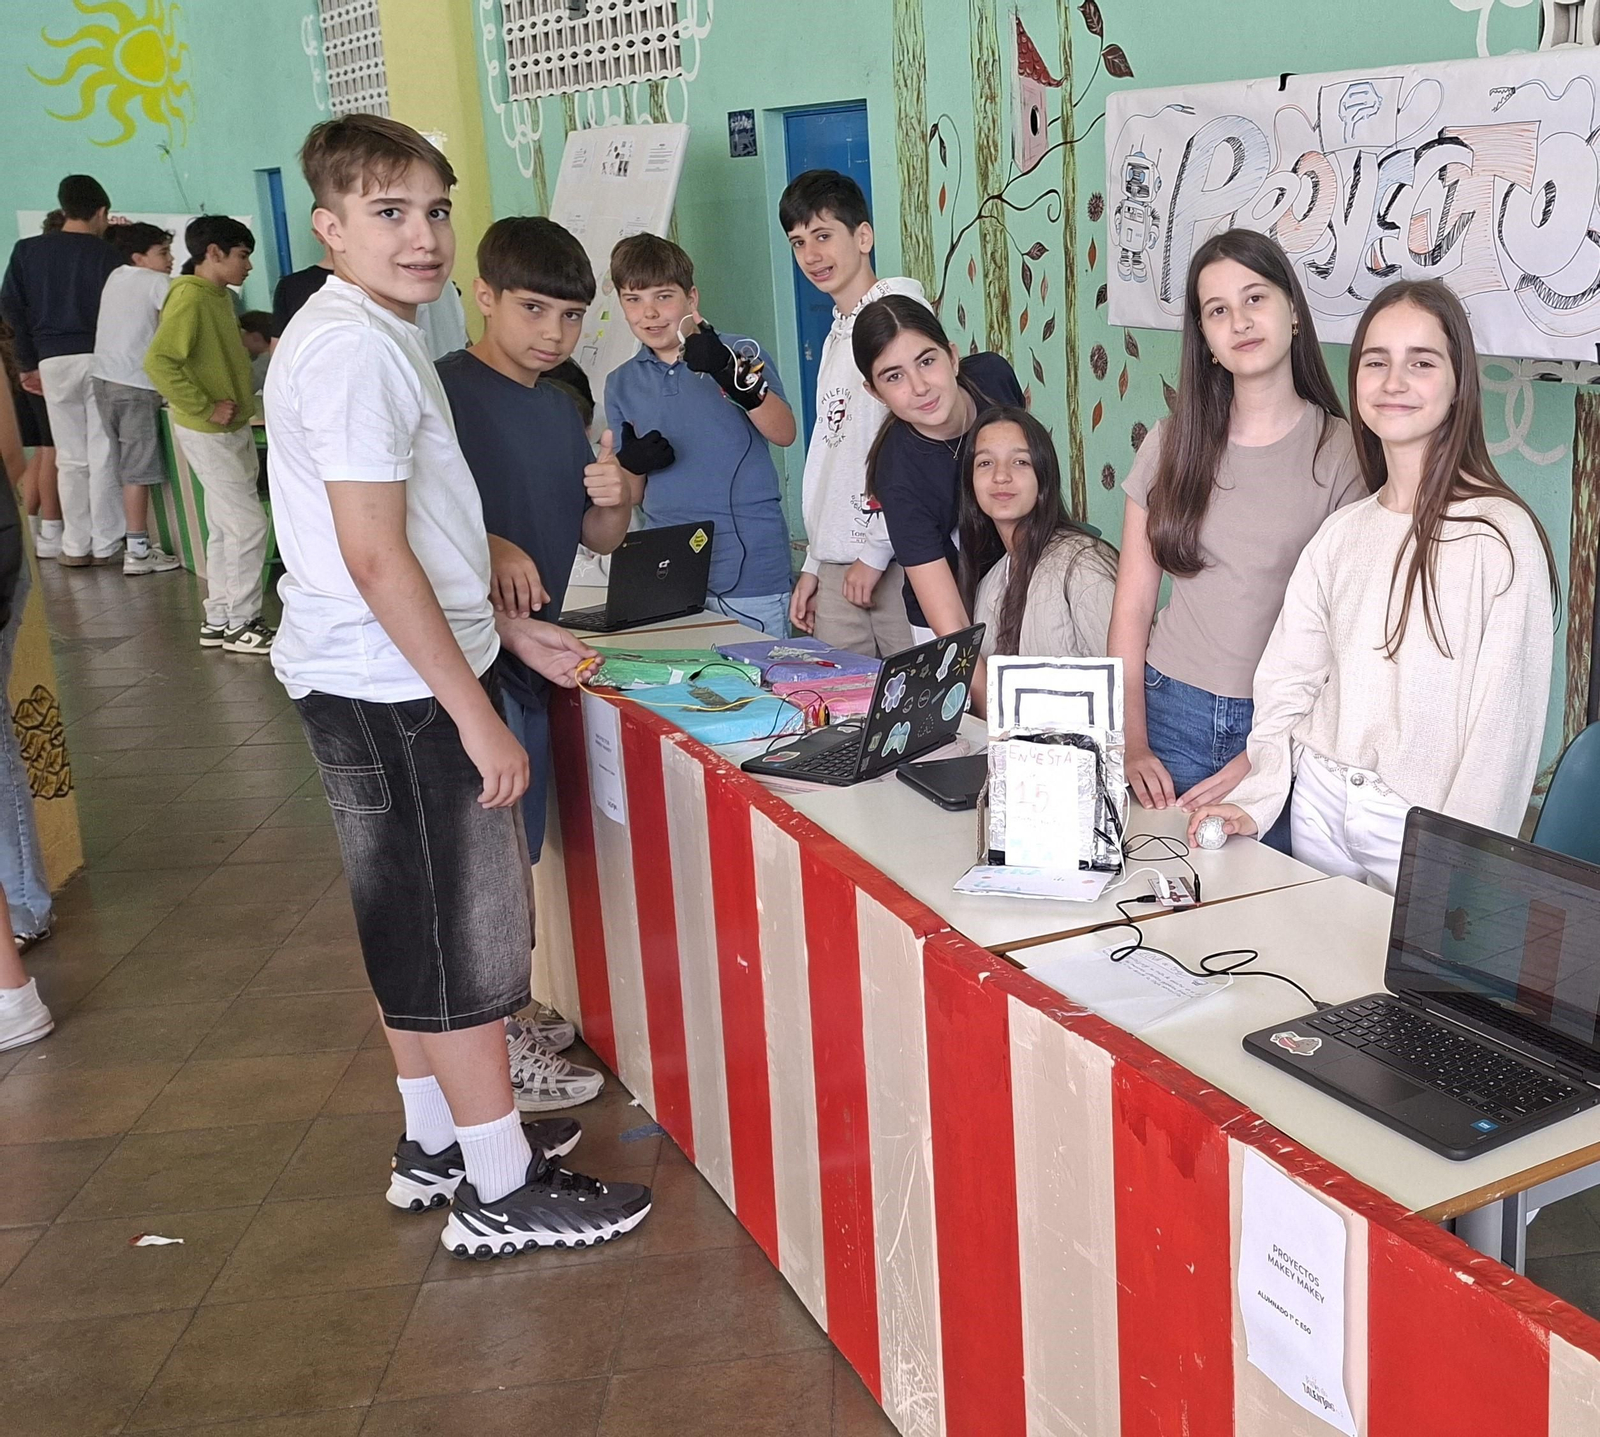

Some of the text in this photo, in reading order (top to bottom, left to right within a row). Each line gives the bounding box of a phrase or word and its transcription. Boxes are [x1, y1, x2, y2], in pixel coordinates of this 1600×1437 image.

[1015, 781, 1050, 813] 15
[1267, 1253, 1325, 1304] MAKEY MAKEY
[1272, 1244, 1320, 1288] PROYECTOS
[1257, 1290, 1289, 1317] ALUMNADO
[1299, 1322, 1312, 1335] ESO
